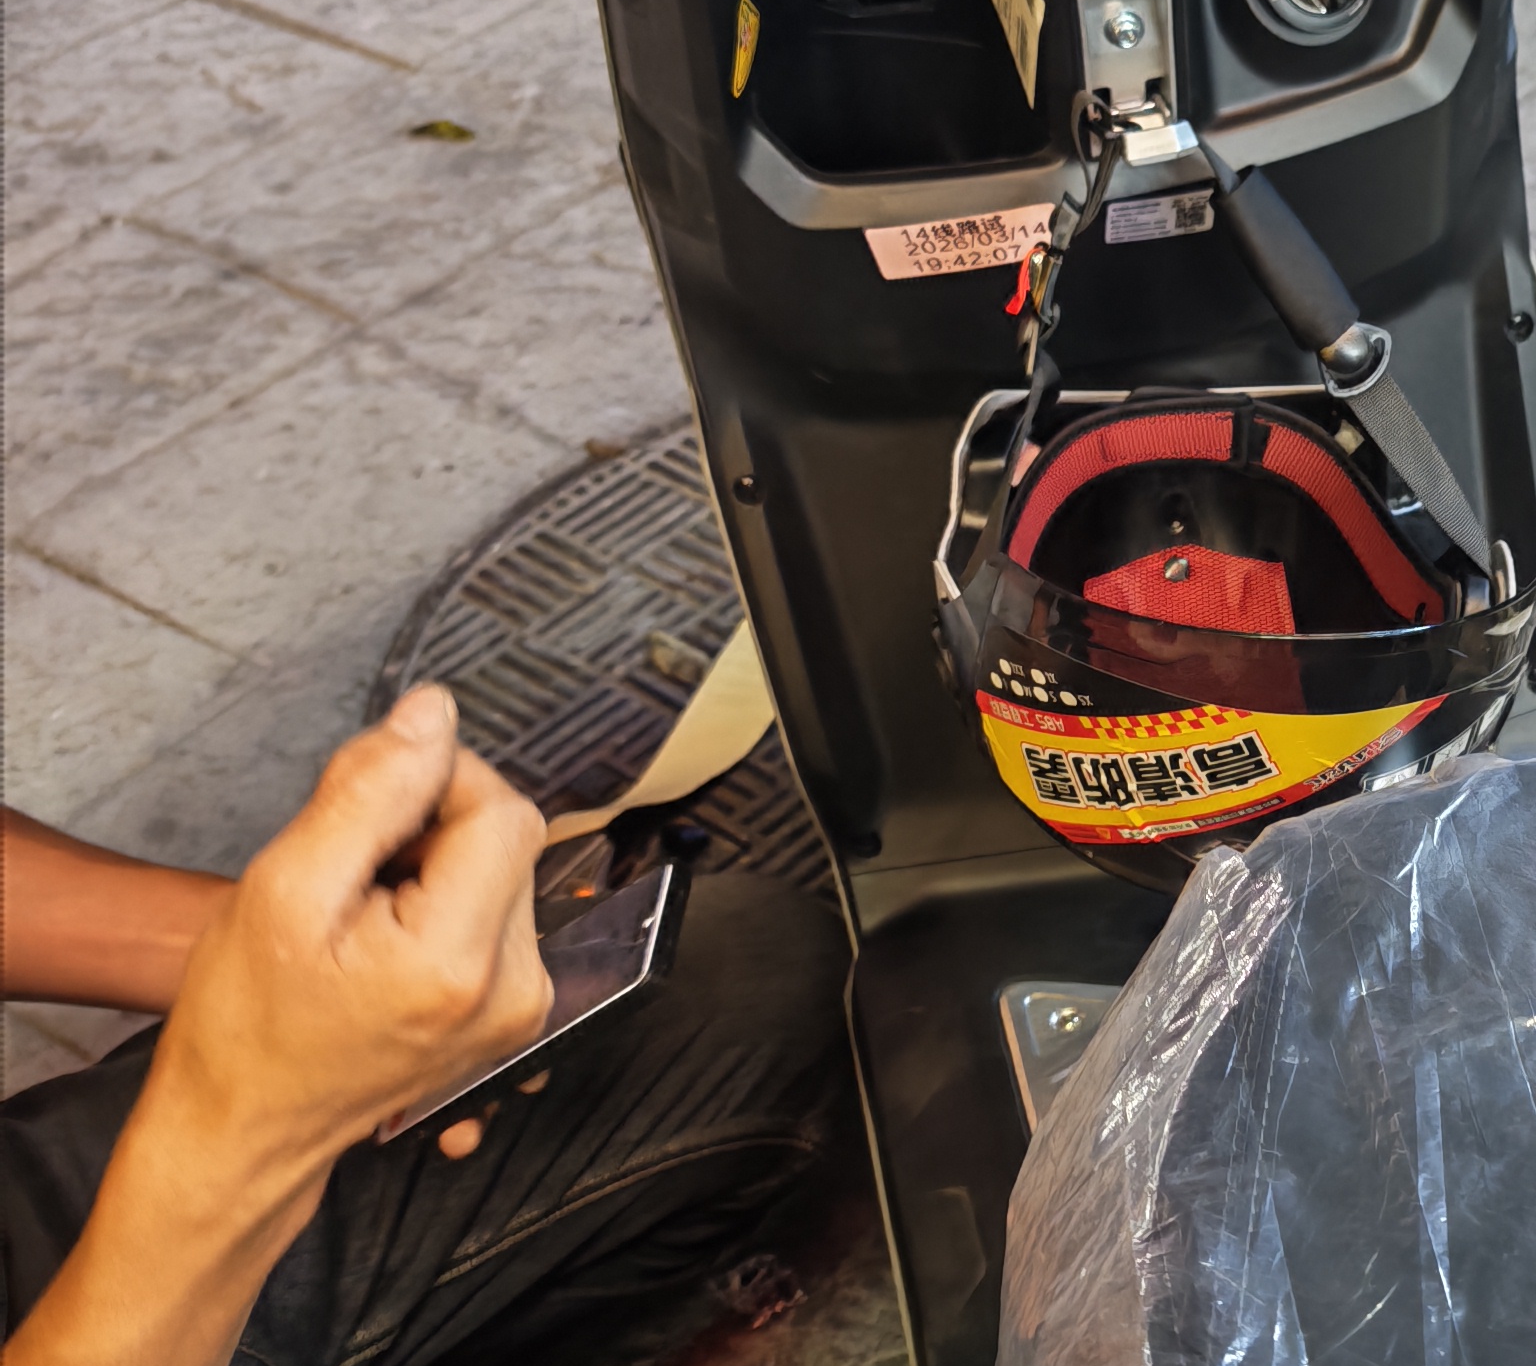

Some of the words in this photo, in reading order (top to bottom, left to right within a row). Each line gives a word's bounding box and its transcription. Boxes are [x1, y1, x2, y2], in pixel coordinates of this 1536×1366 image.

[1034, 714, 1065, 733] ABS
[1022, 733, 1279, 812] 高清防雾
